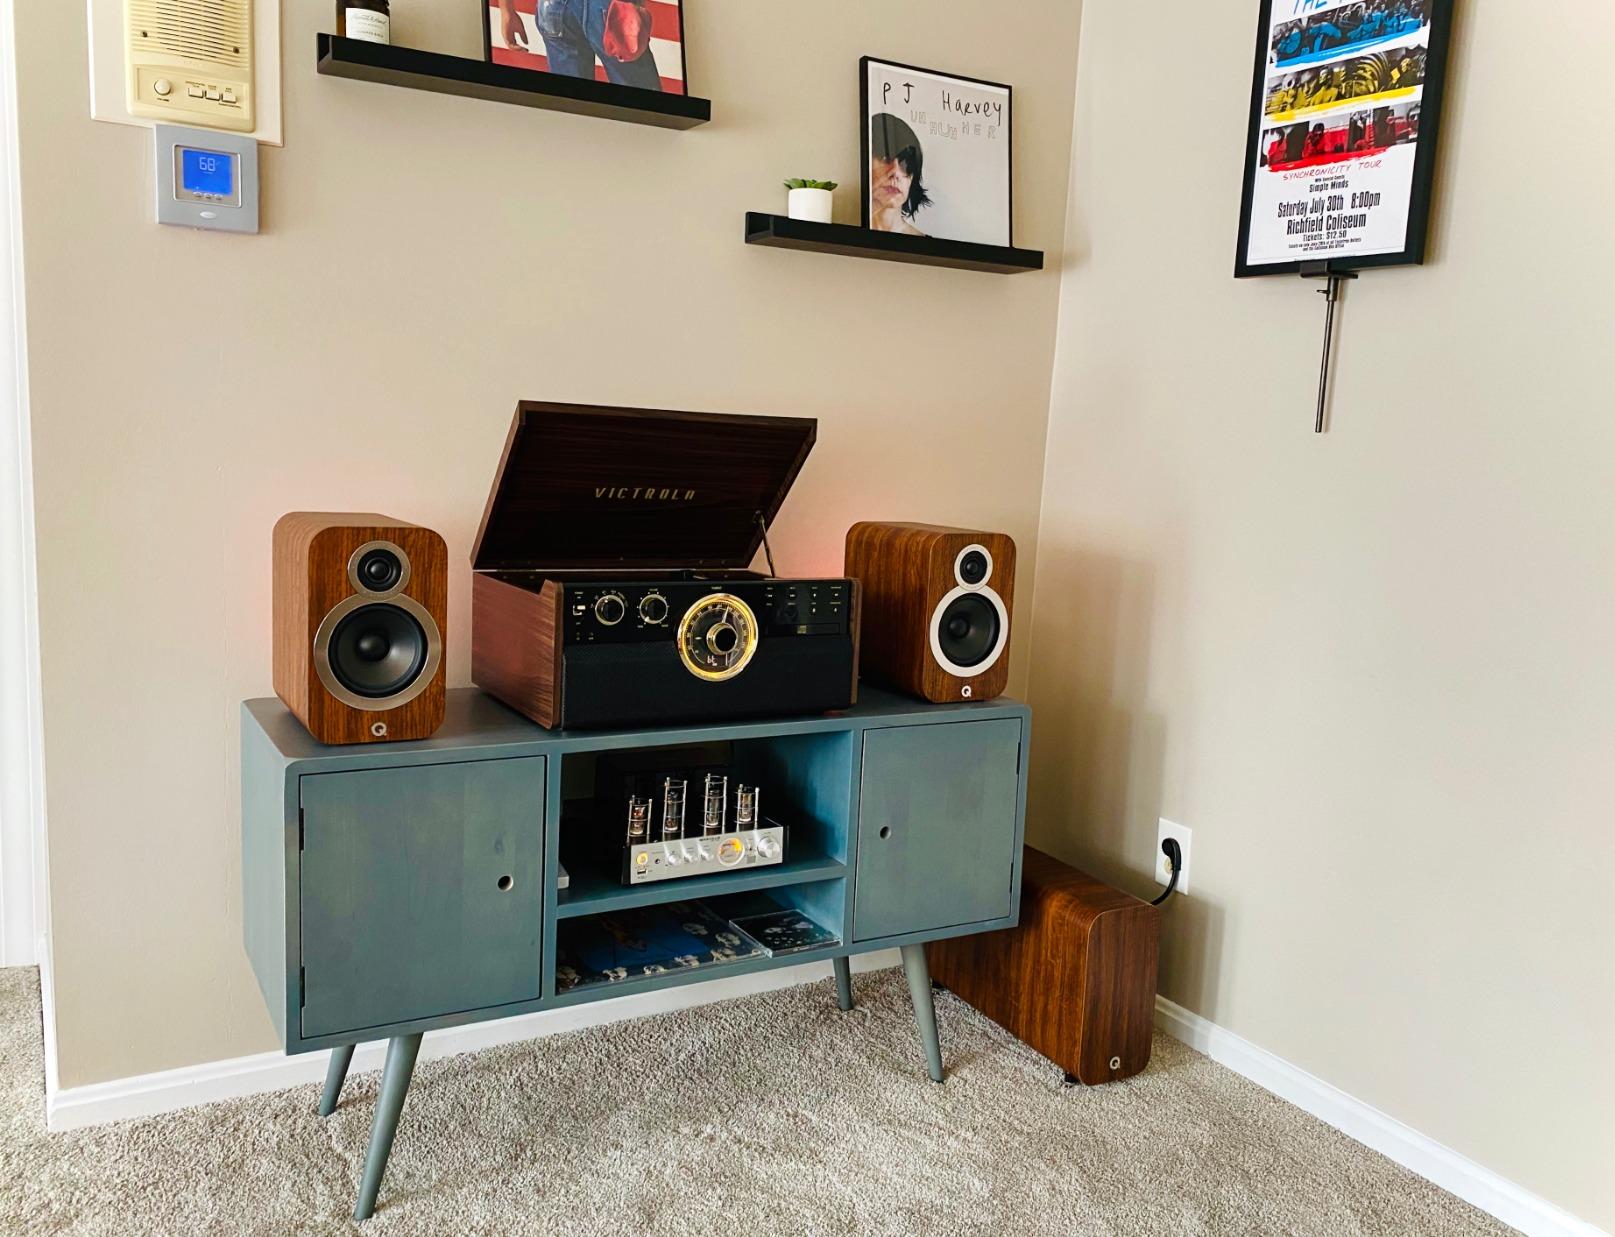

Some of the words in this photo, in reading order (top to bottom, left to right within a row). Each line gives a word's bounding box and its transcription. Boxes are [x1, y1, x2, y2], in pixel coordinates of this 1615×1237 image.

[942, 90, 1001, 127] Harvey
[199, 157, 216, 172] 68
[1283, 165, 1351, 180] SYNCHRONICITY
[1359, 160, 1382, 169] TOUR
[1309, 183, 1328, 192] Simple
[1330, 180, 1349, 189] Minds
[1277, 200, 1309, 218] Saturday
[1309, 197, 1326, 216] July
[1326, 194, 1344, 212] 30th
[1350, 191, 1381, 210] 8:00pm
[1286, 216, 1324, 235] Richfield
[1325, 213, 1367, 232] Coliseum
[1303, 233, 1325, 242] Tickets:
[1325, 229, 1347, 240] $12.50
[594, 487, 696, 501] VICTROLA
